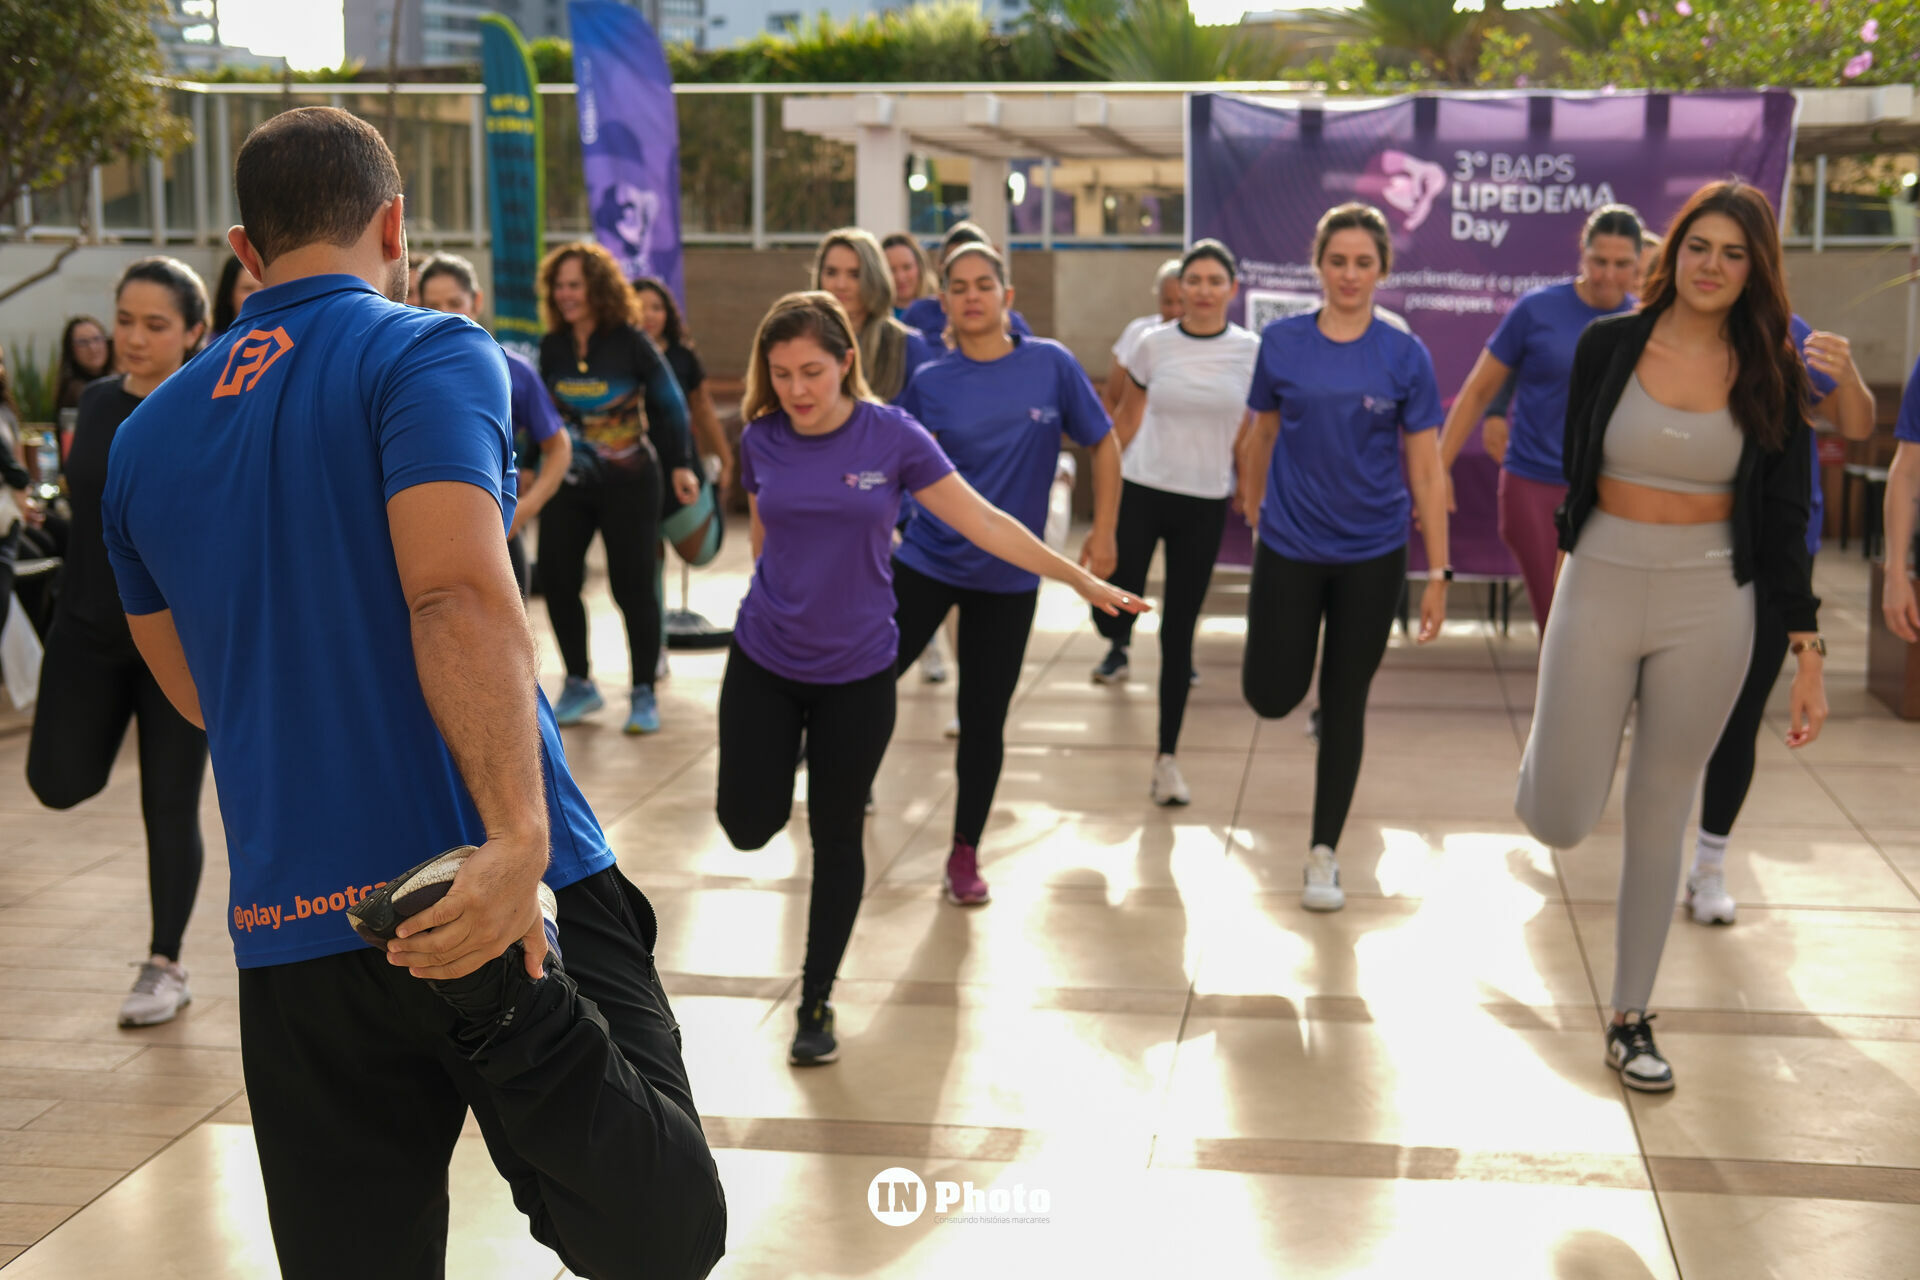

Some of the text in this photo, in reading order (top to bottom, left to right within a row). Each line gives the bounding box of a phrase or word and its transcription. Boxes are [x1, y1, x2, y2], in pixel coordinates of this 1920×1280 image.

[1490, 152, 1576, 183] BAPS
[1452, 181, 1616, 214] LIPEDEMA
[1451, 211, 1510, 248] Day
[233, 881, 387, 932] @play_bootc
